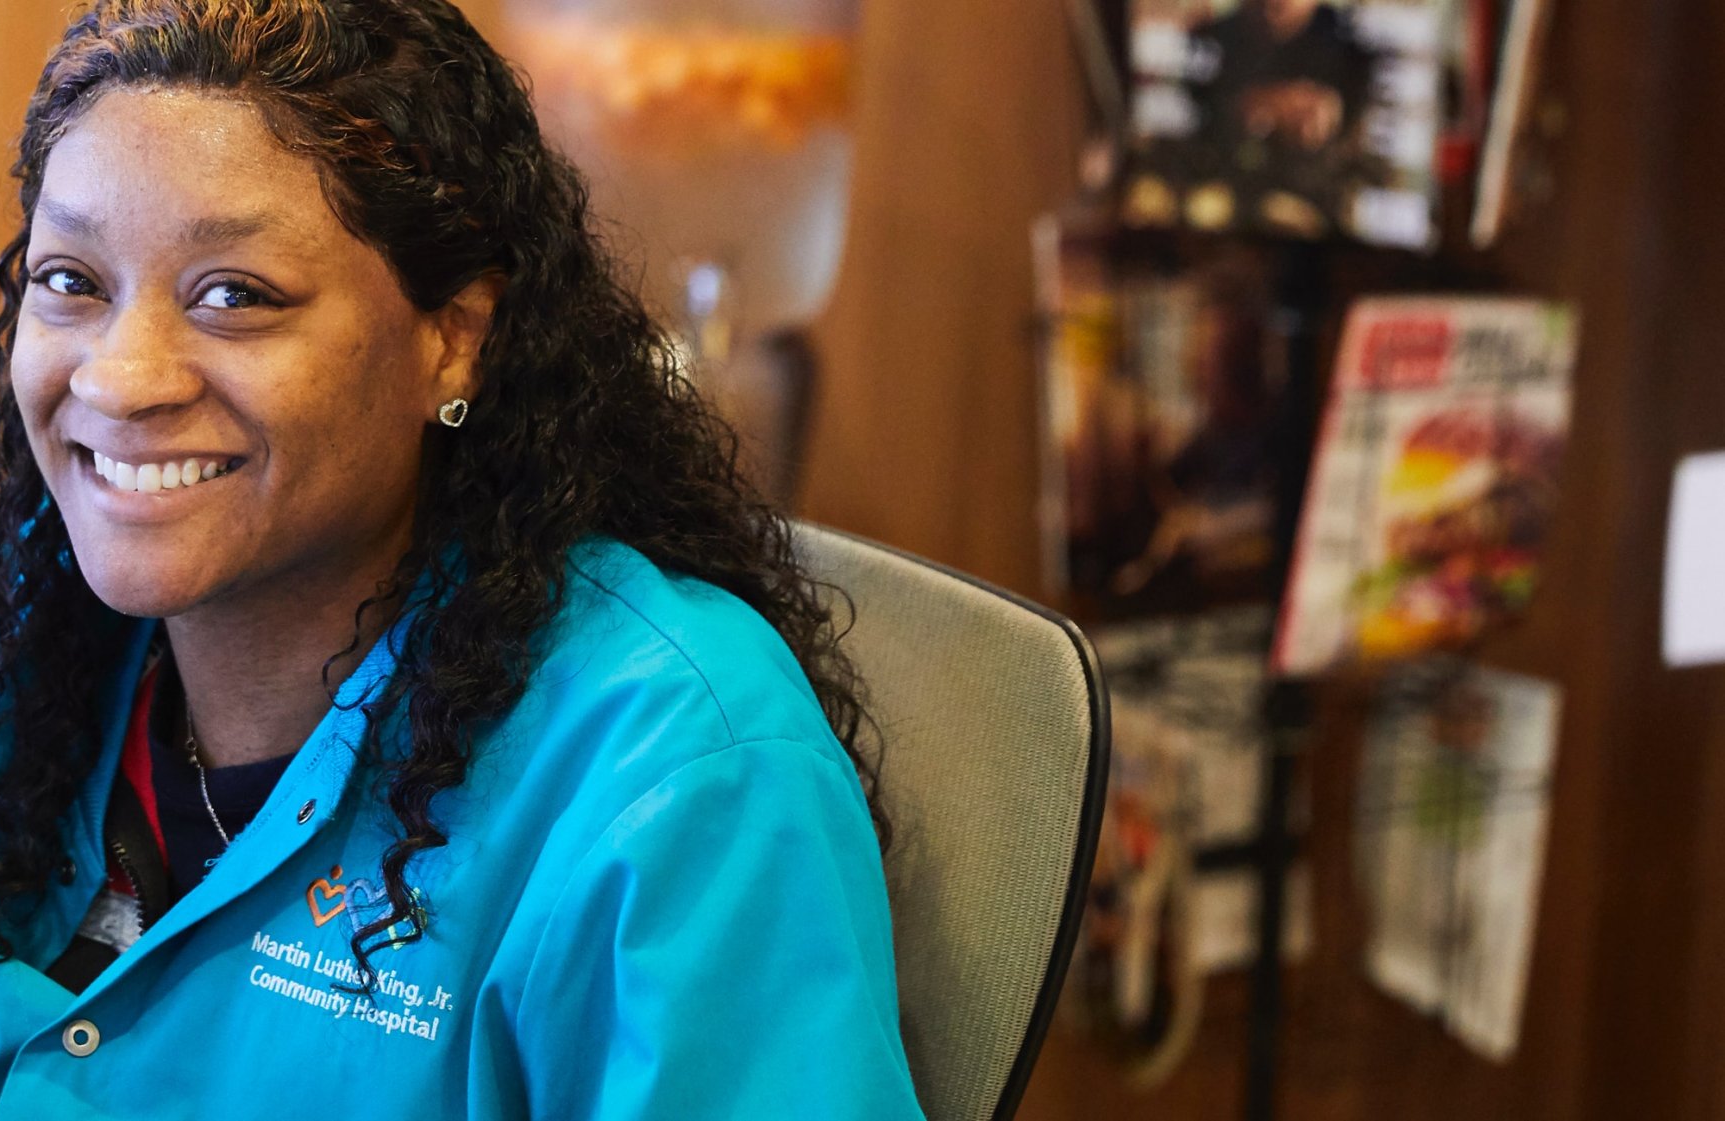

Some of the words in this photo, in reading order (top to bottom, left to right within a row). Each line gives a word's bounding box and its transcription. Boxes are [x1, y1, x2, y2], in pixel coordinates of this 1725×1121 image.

[250, 965, 351, 1019] Community
[352, 997, 440, 1041] Hospital
[251, 931, 311, 969] Martin
[374, 969, 424, 1007] King,
[427, 985, 453, 1011] Jr.
